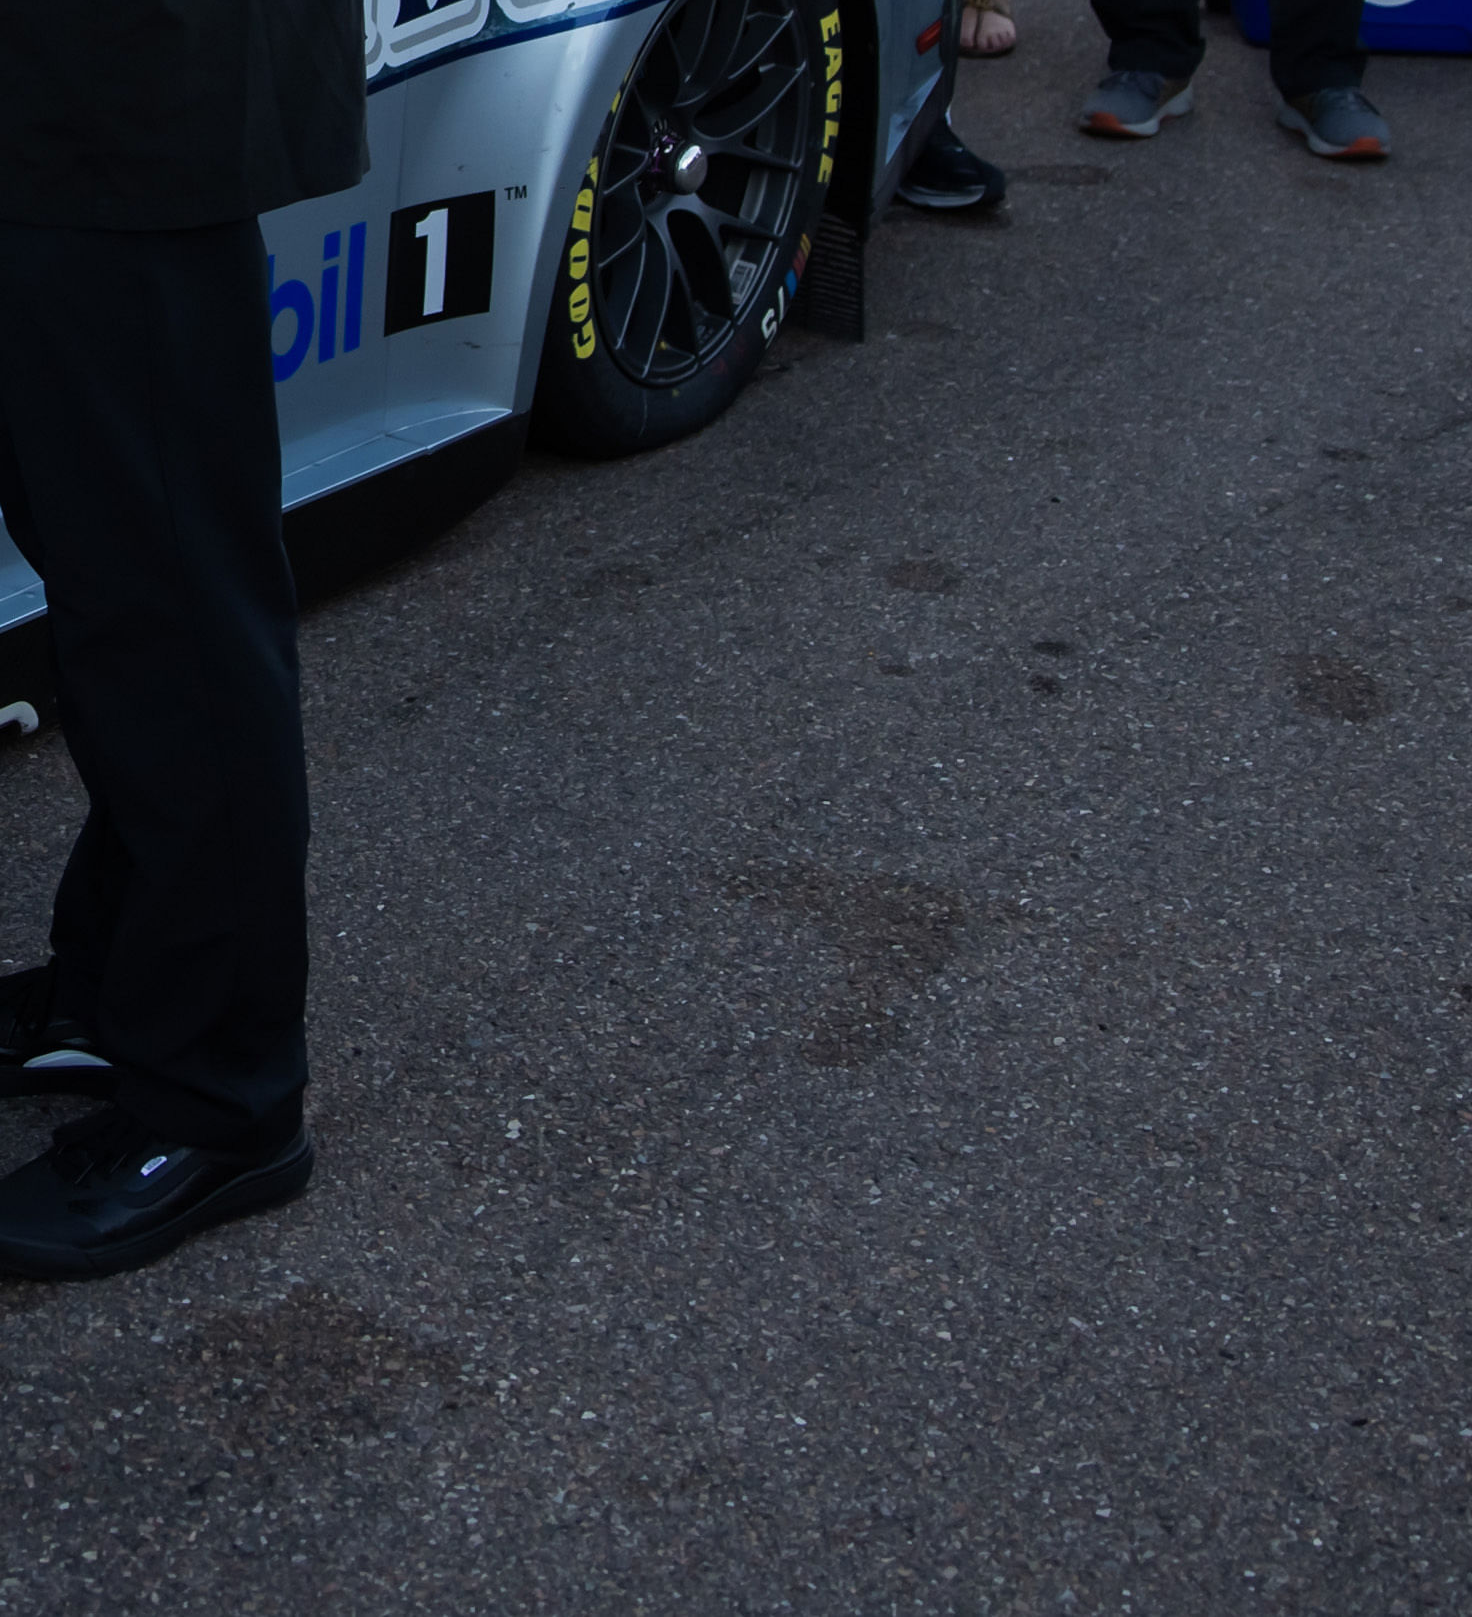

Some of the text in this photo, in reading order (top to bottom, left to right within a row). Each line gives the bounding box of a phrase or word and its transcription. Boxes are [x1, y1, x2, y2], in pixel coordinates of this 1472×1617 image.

[817, 7, 844, 185] EAGLE
[503, 184, 528, 202] TM
[414, 208, 449, 317] 1
